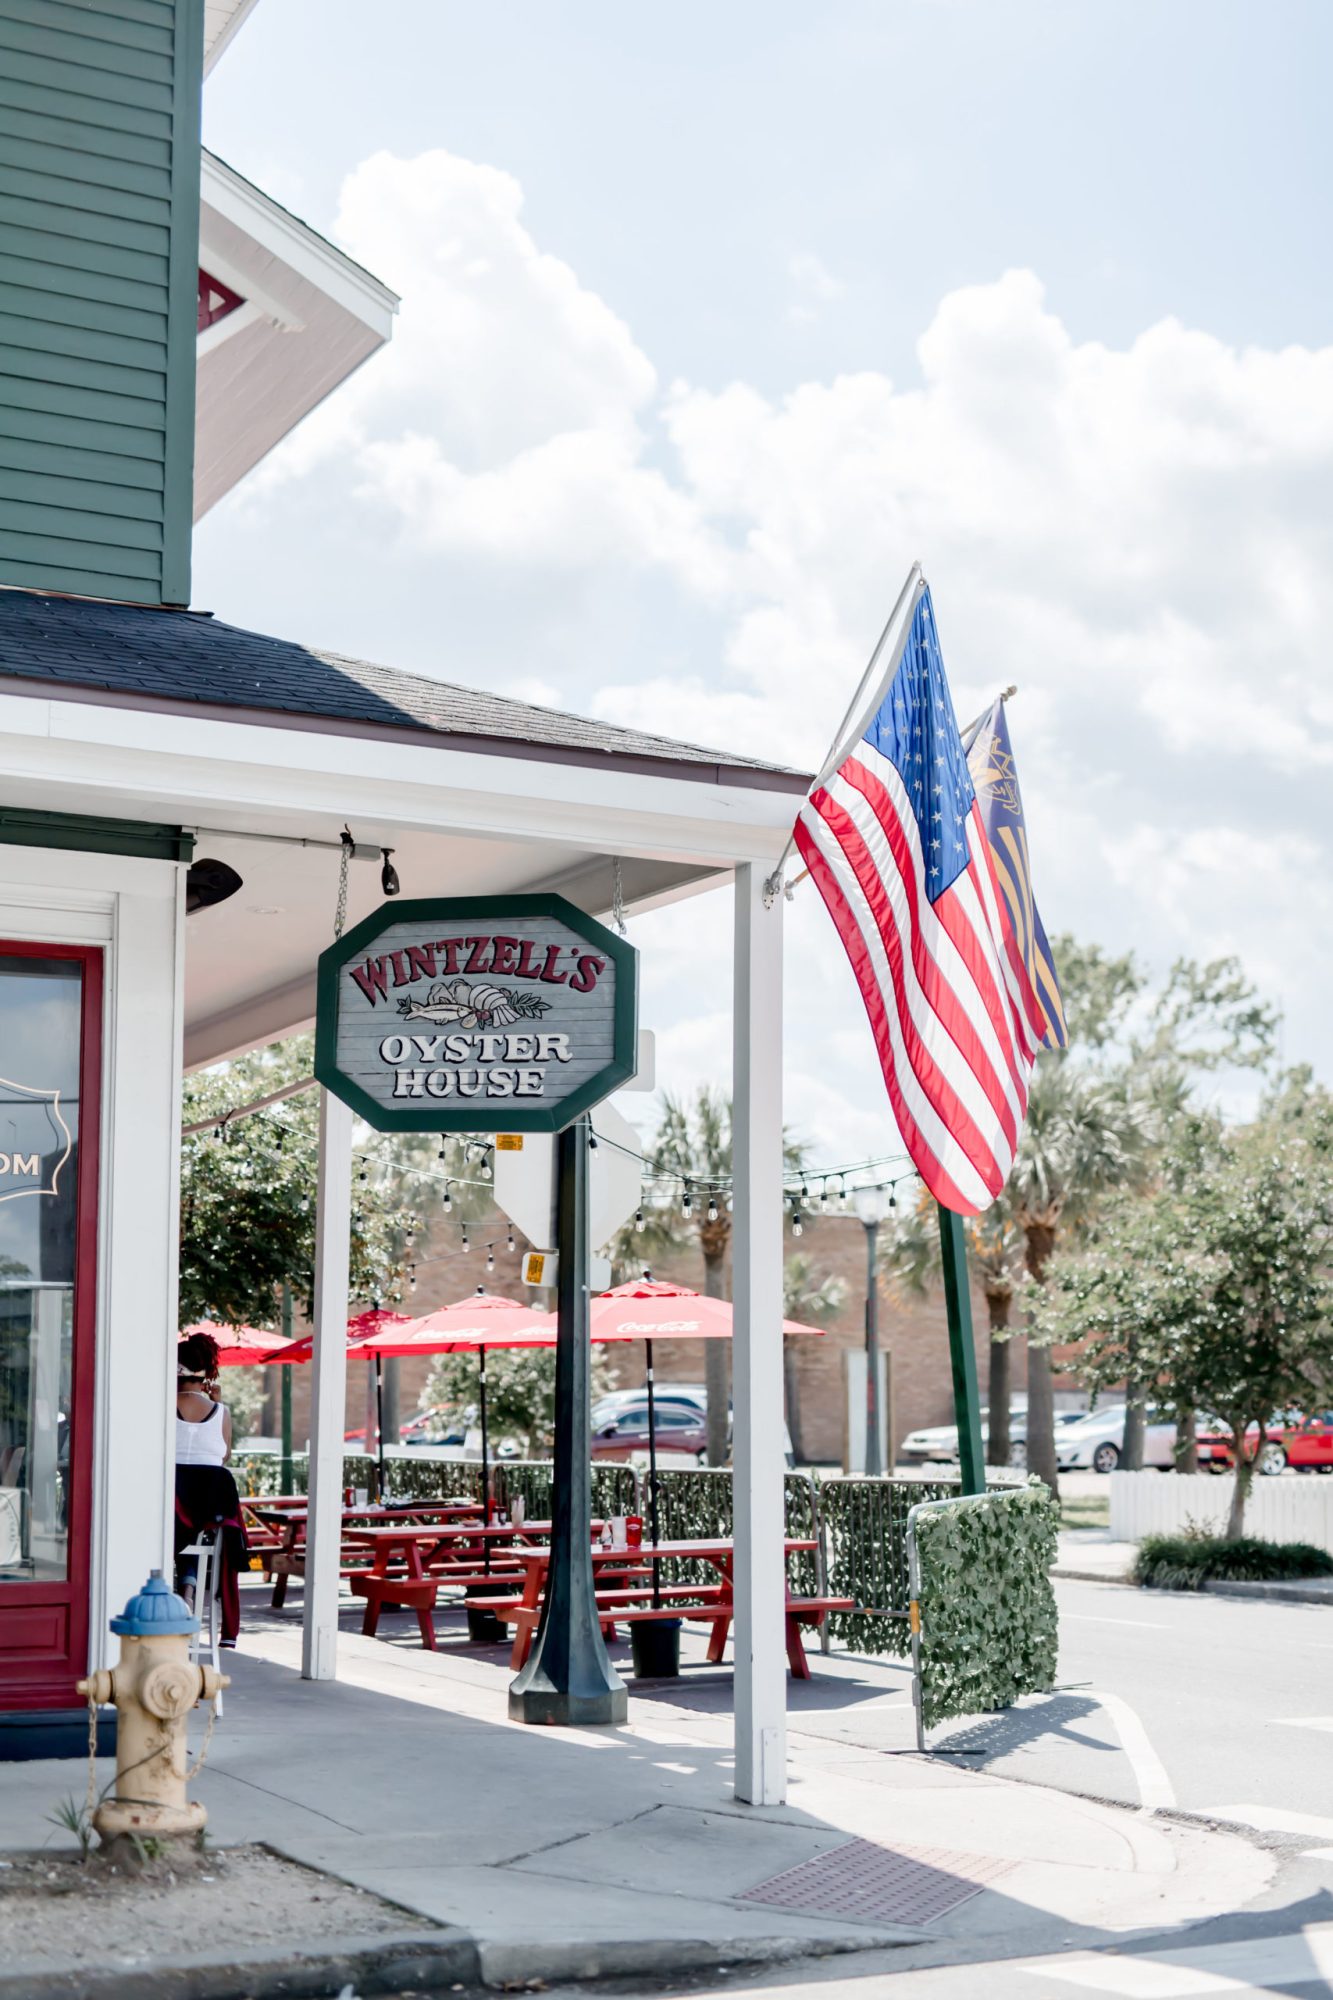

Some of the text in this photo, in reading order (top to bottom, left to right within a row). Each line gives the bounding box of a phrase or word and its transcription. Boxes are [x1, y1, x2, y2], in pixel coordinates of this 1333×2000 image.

[349, 935, 606, 1007] WINTZELL'S
[379, 1034, 573, 1064] OYSTER
[392, 1068, 546, 1098] HOUSE
